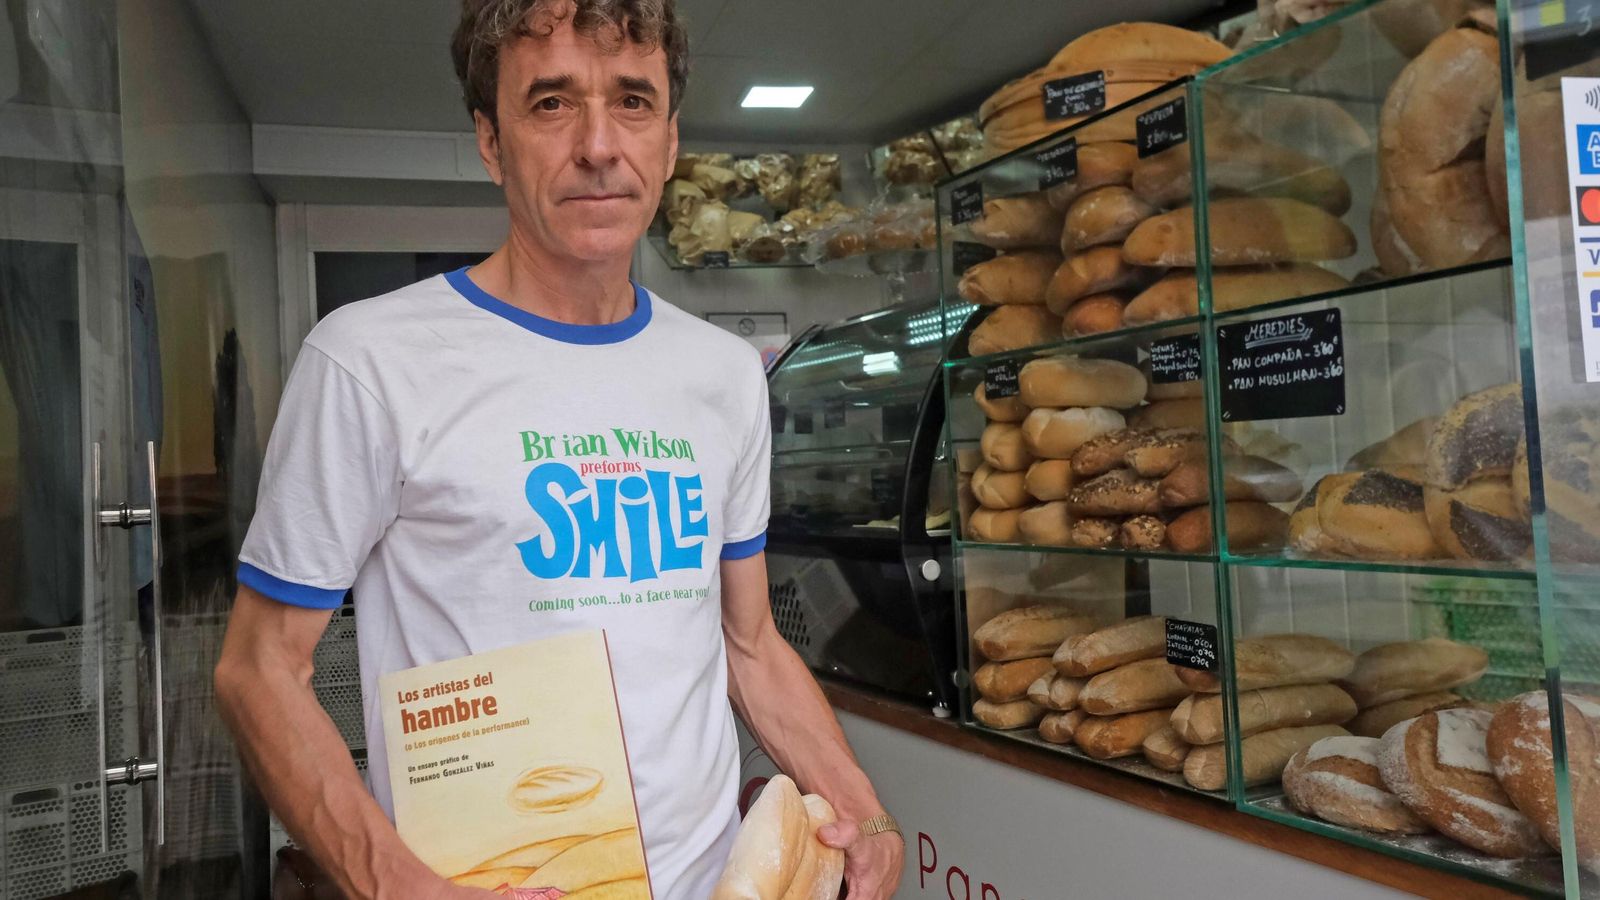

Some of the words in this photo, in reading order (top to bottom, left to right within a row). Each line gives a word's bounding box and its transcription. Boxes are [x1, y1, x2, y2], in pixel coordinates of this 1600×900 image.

[518, 430, 610, 462] Brian
[610, 428, 696, 463] Wilson
[580, 460, 642, 477] preforms
[635, 593, 643, 604] a
[646, 588, 671, 603] face
[673, 588, 693, 600] near
[397, 690, 419, 705] Los
[422, 678, 470, 699] artistas
[473, 671, 494, 688] del
[400, 695, 498, 735] hambre
[414, 739, 427, 750] Los
[461, 729, 471, 739] de
[472, 727, 480, 737] la
[481, 717, 530, 736] performance)
[407, 765, 416, 773] Un
[417, 760, 438, 772] ensayo
[439, 755, 460, 768] gráfico
[461, 753, 469, 761] de
